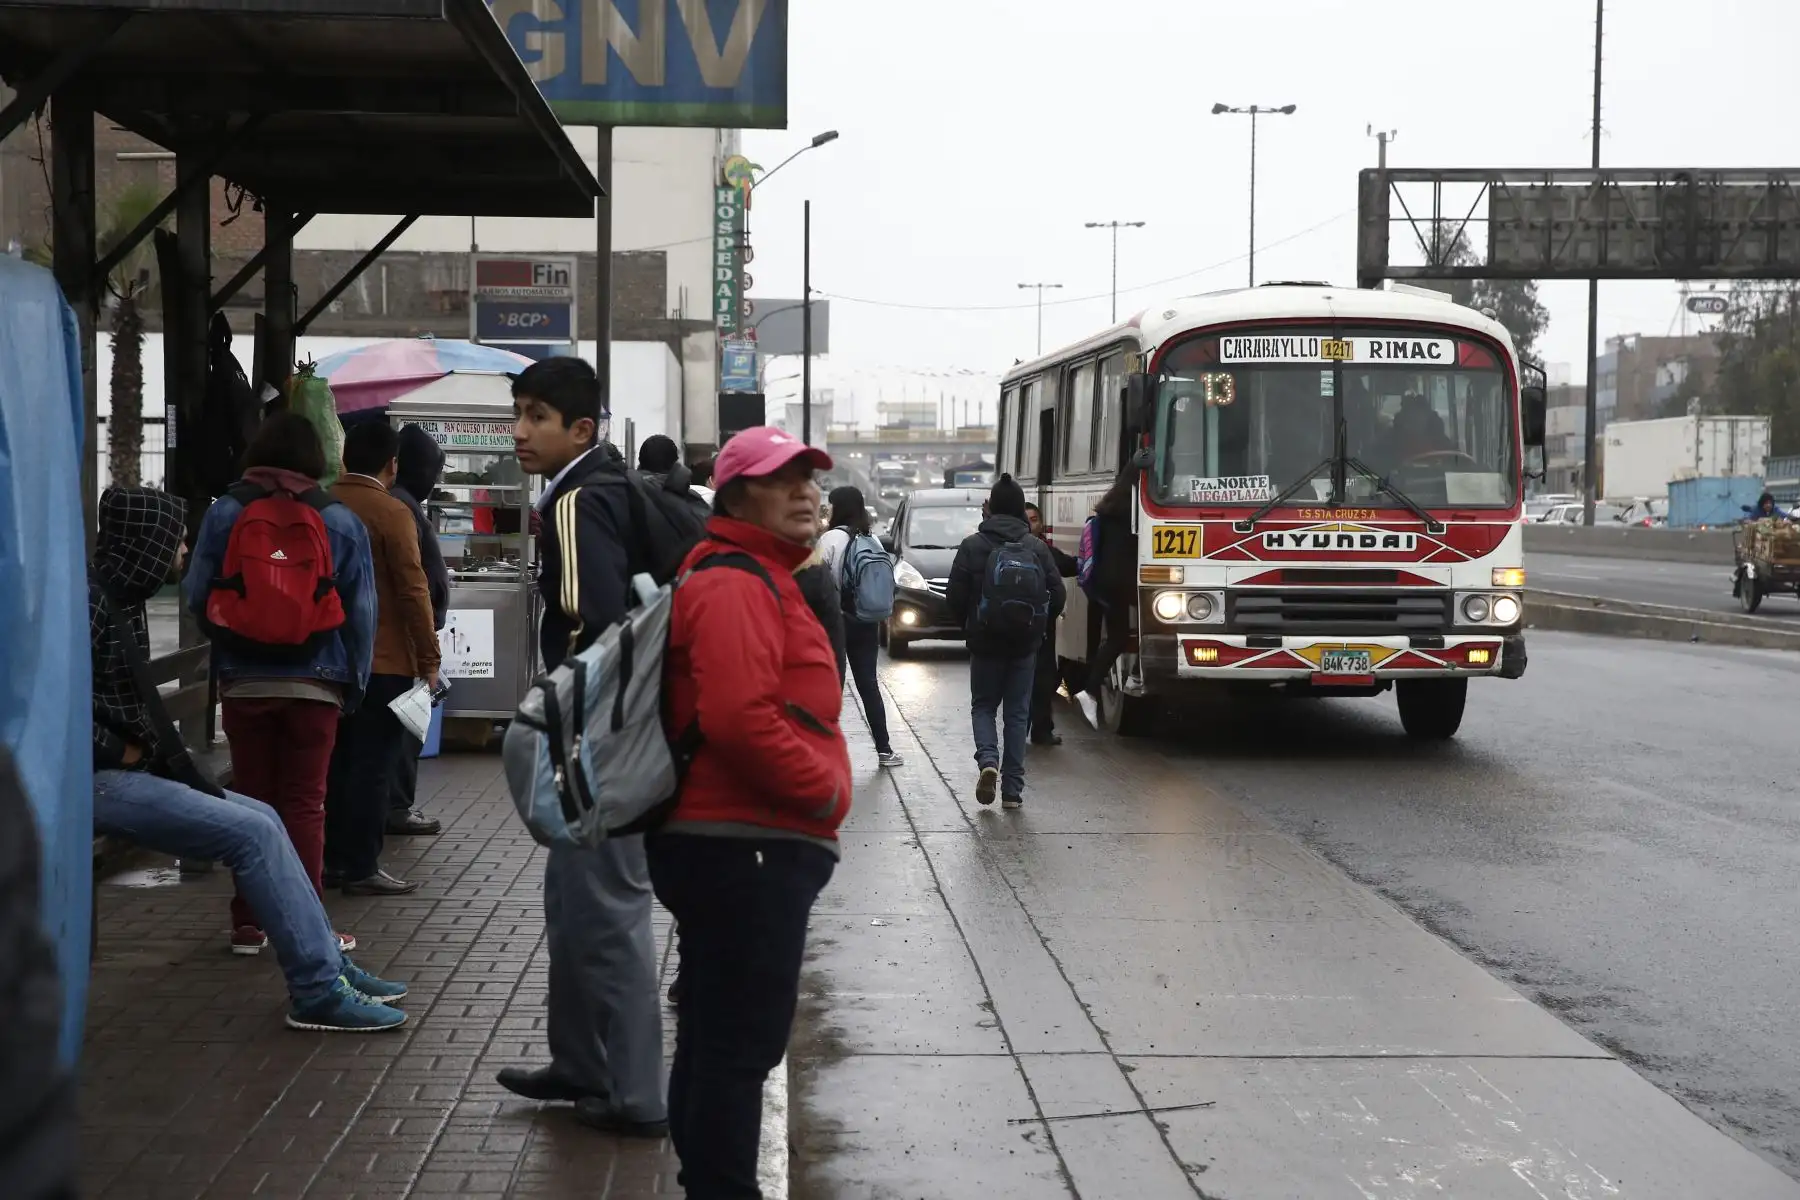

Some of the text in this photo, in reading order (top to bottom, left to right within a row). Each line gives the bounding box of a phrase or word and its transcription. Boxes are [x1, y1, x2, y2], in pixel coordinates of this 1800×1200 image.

[489, 0, 766, 88] GNV
[717, 189, 735, 327] HOSPEDAJE
[533, 264, 568, 284] Fin
[507, 312, 541, 327] BCP
[1223, 338, 1441, 359] CARABAYLLO 1217 RIMAC
[1201, 373, 1235, 405] 13
[452, 435, 479, 444] VARIEDAD
[481, 435, 488, 445] DE
[1192, 489, 1268, 502] MEGAPLAZA
[1154, 530, 1197, 554] 1217
[1266, 533, 1413, 549] HYUNDAI
[1323, 657, 1368, 671] B4K-738
